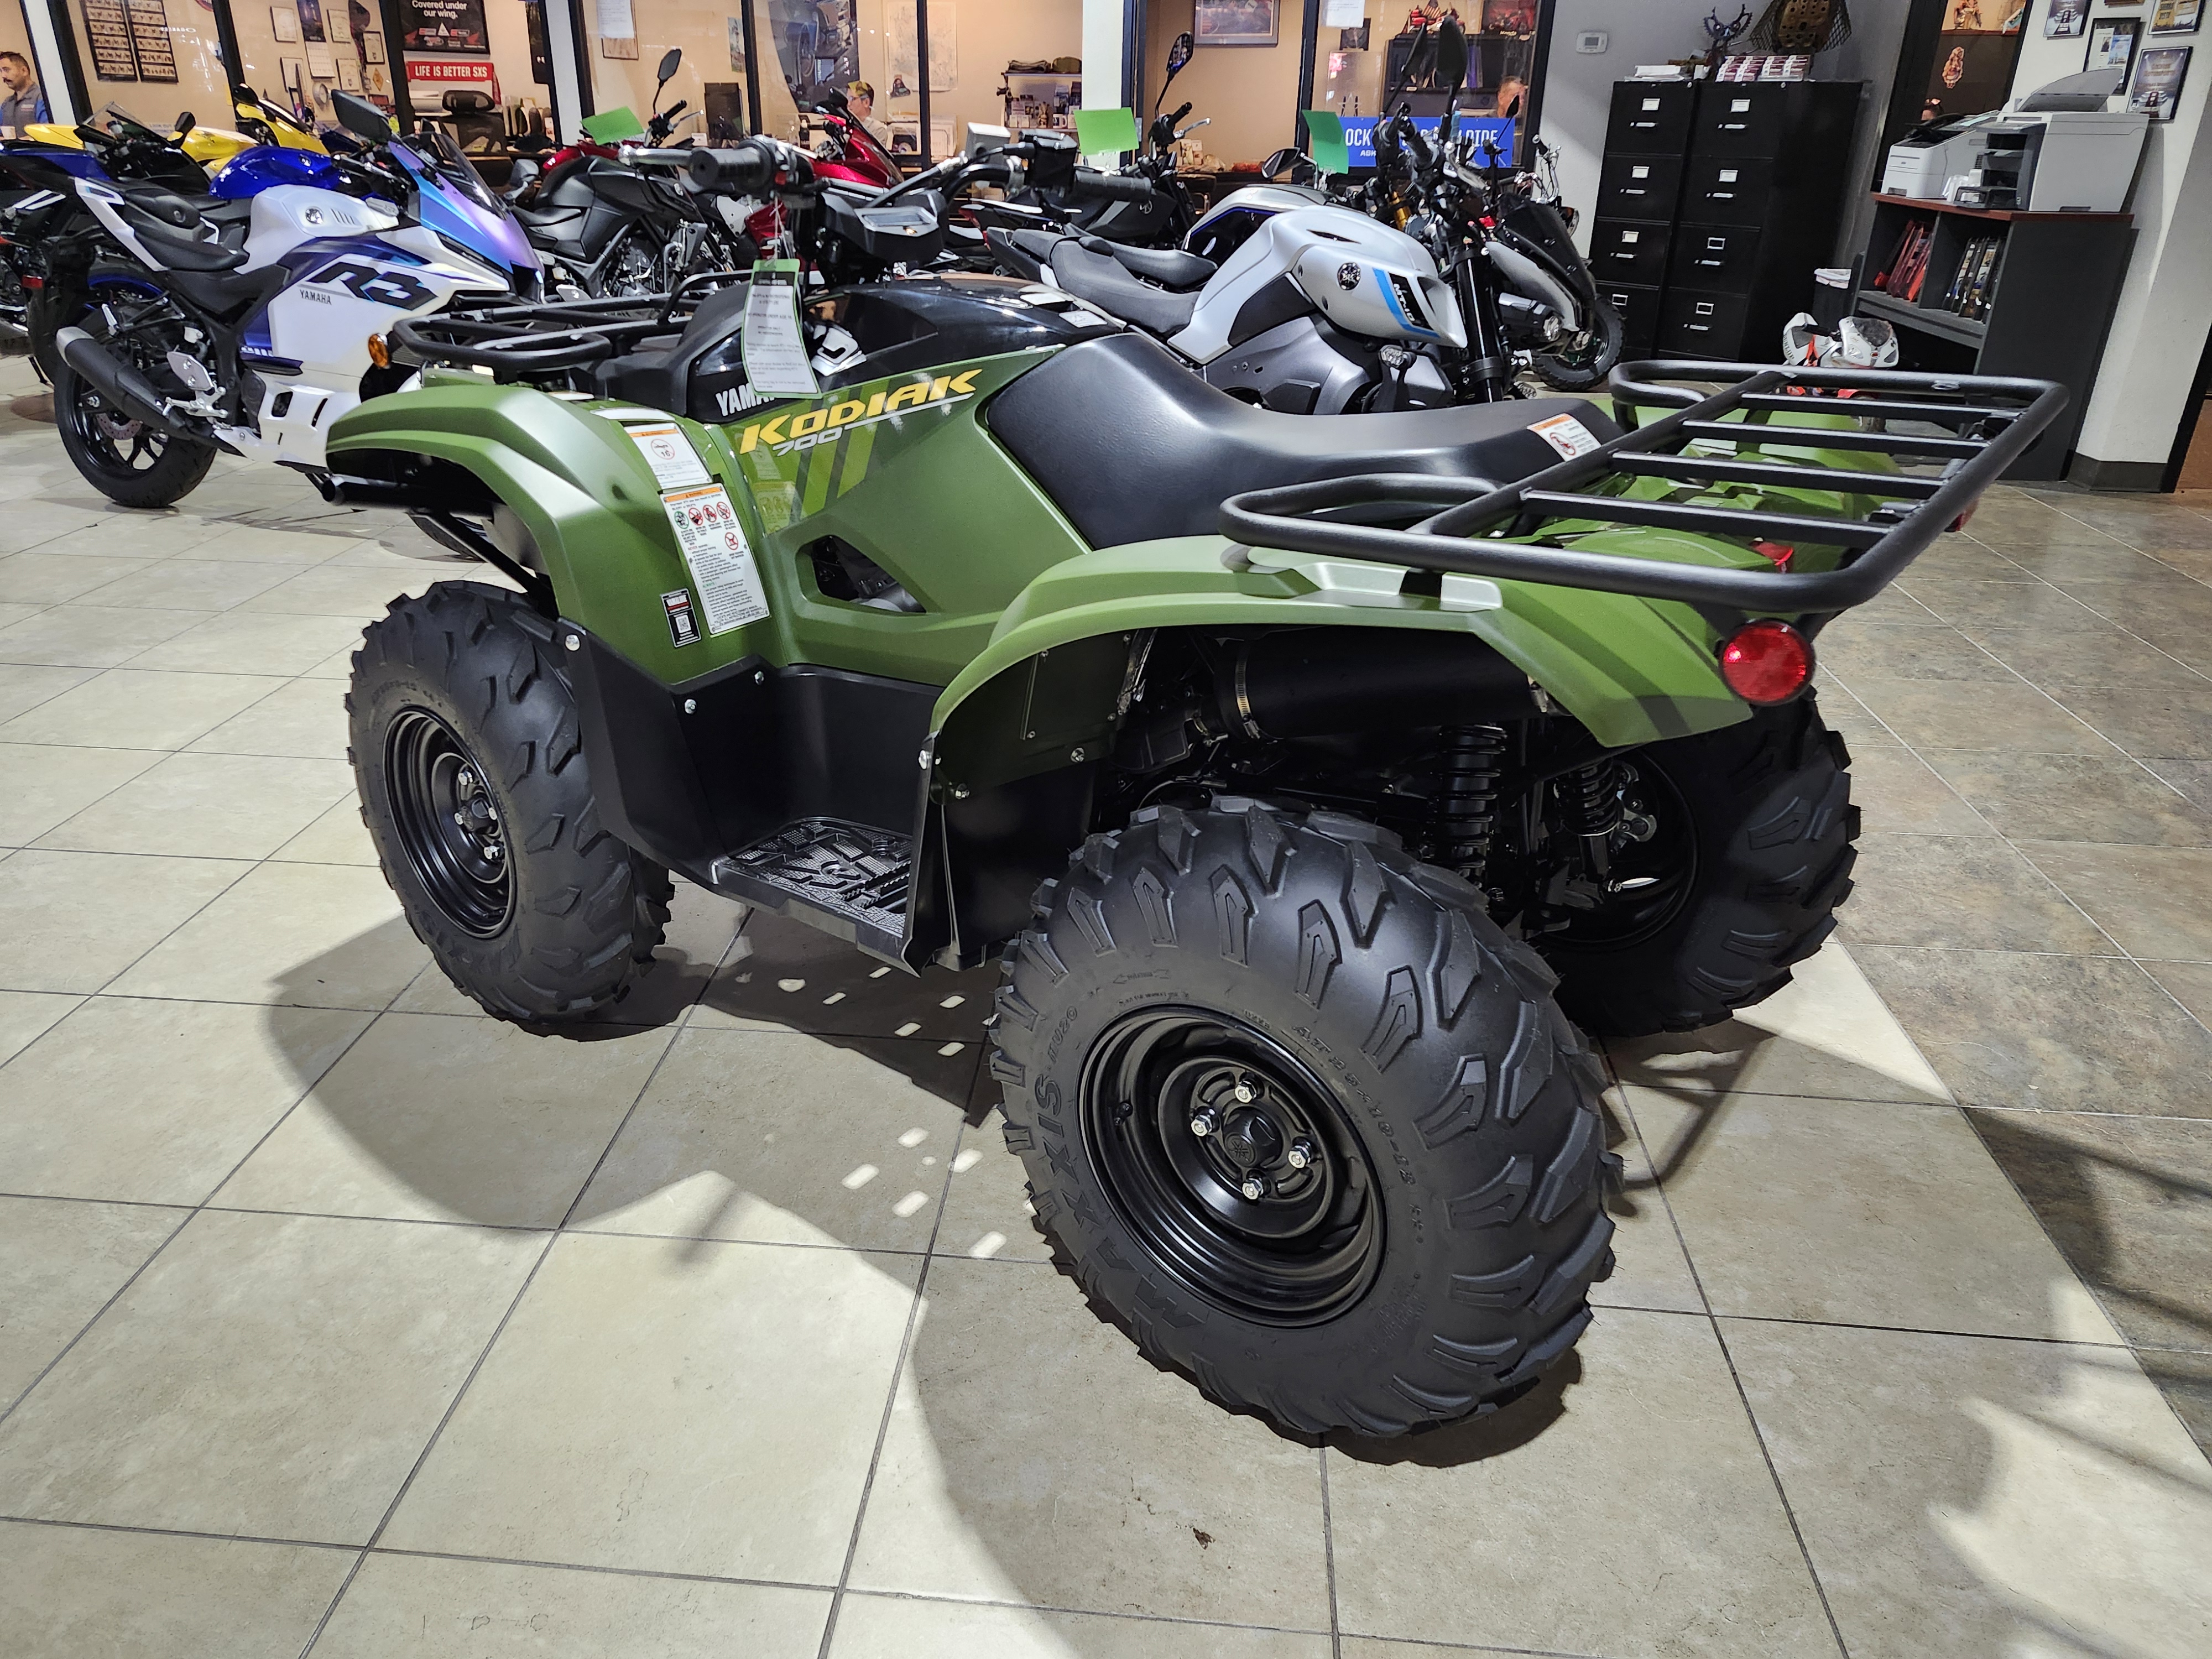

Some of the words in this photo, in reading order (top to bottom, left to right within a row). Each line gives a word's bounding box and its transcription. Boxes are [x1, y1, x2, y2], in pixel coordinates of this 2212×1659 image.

[438, 9, 458, 19] wing.
[445, 1, 467, 10] under
[415, 65, 430, 76] LIFE
[434, 65, 441, 76] IS
[443, 66, 471, 77] BETTER
[473, 66, 488, 77] SXS
[1345, 128, 1372, 147] OCK
[300, 289, 332, 305] YAMAHA
[716, 383, 775, 416] YAM
[739, 369, 983, 455] KODIAK
[773, 427, 843, 457] 700
[1033, 1074, 1204, 1329] MAXXIS
